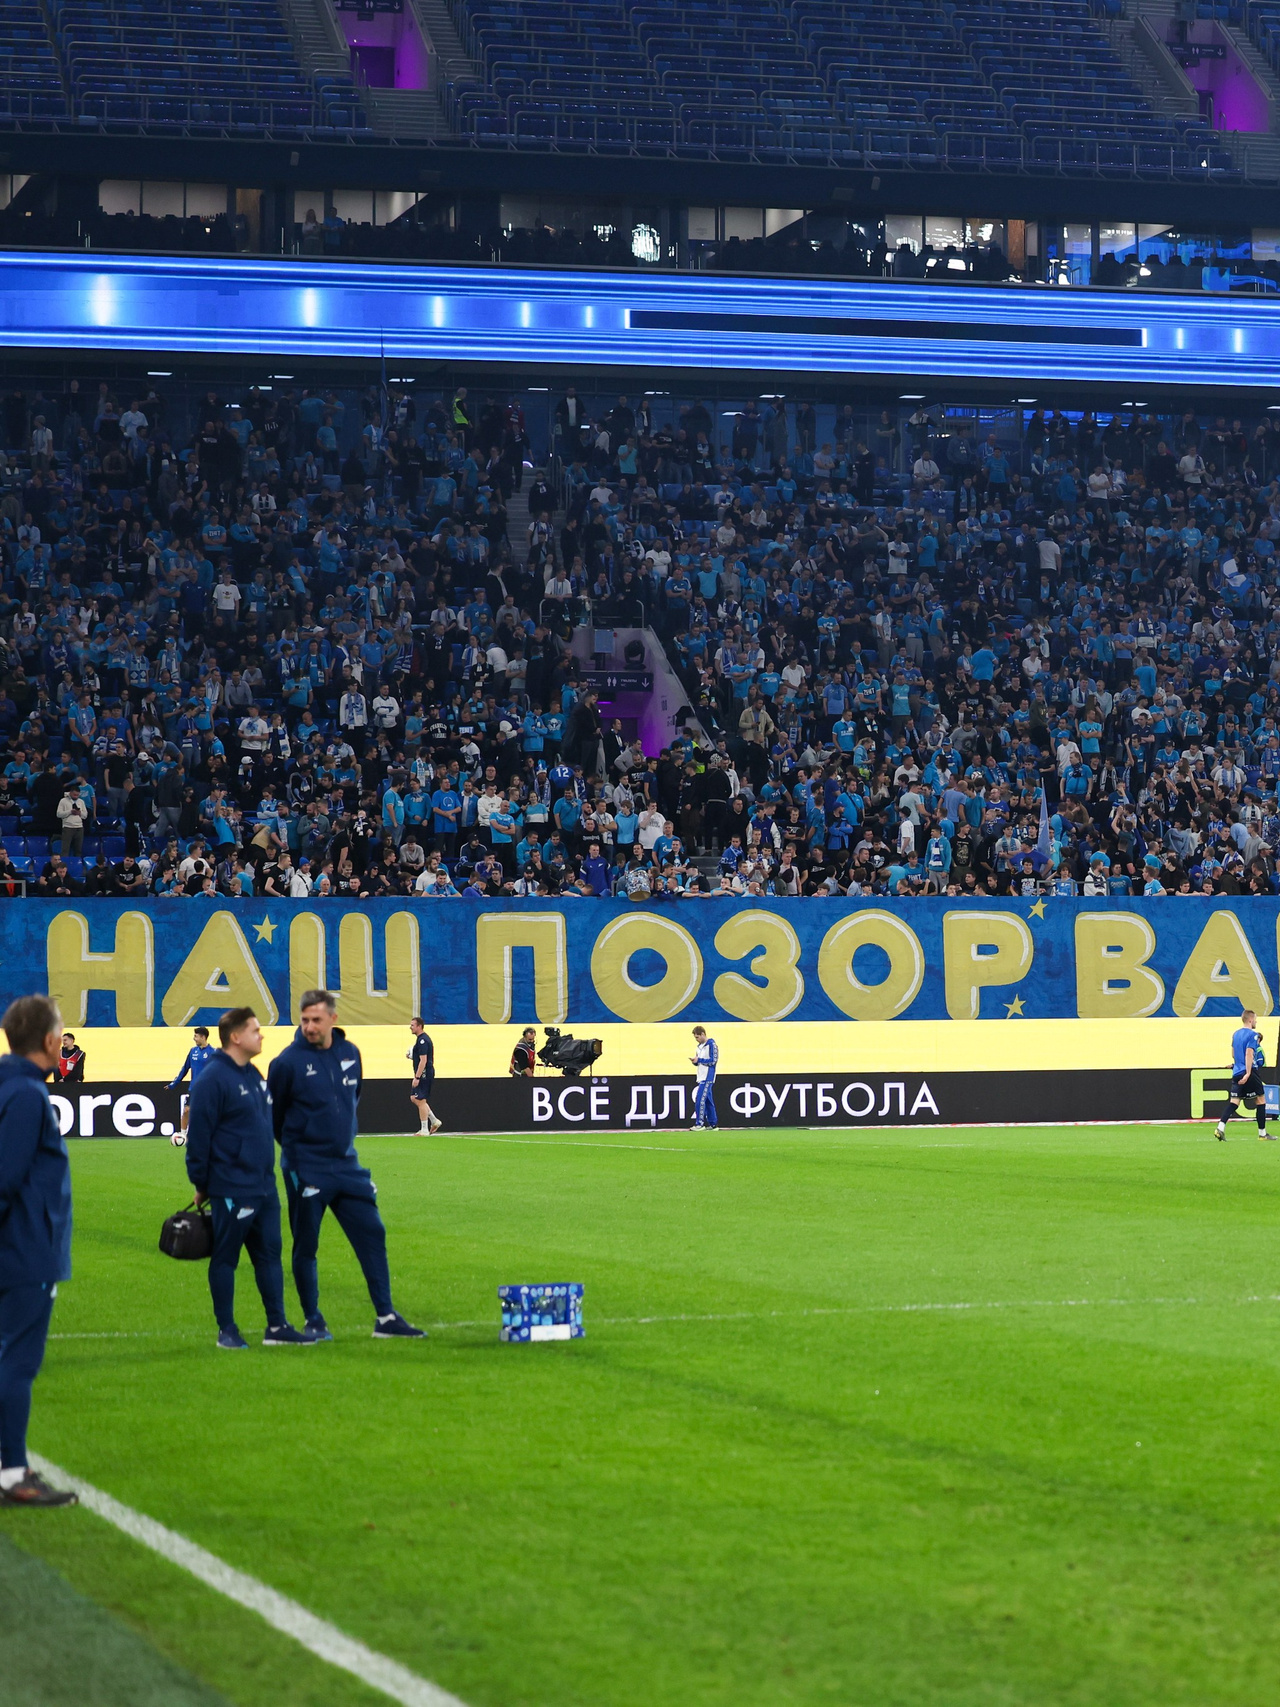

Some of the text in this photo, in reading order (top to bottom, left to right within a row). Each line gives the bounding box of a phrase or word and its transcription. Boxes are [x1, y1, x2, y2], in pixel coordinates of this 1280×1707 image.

[555, 768, 570, 778] 12
[47, 910, 421, 1028] НАШ
[476, 908, 1034, 1024] ПОЗОР
[532, 1077, 610, 1122] ВСЁ
[730, 1081, 940, 1119] ФУТБОЛА
